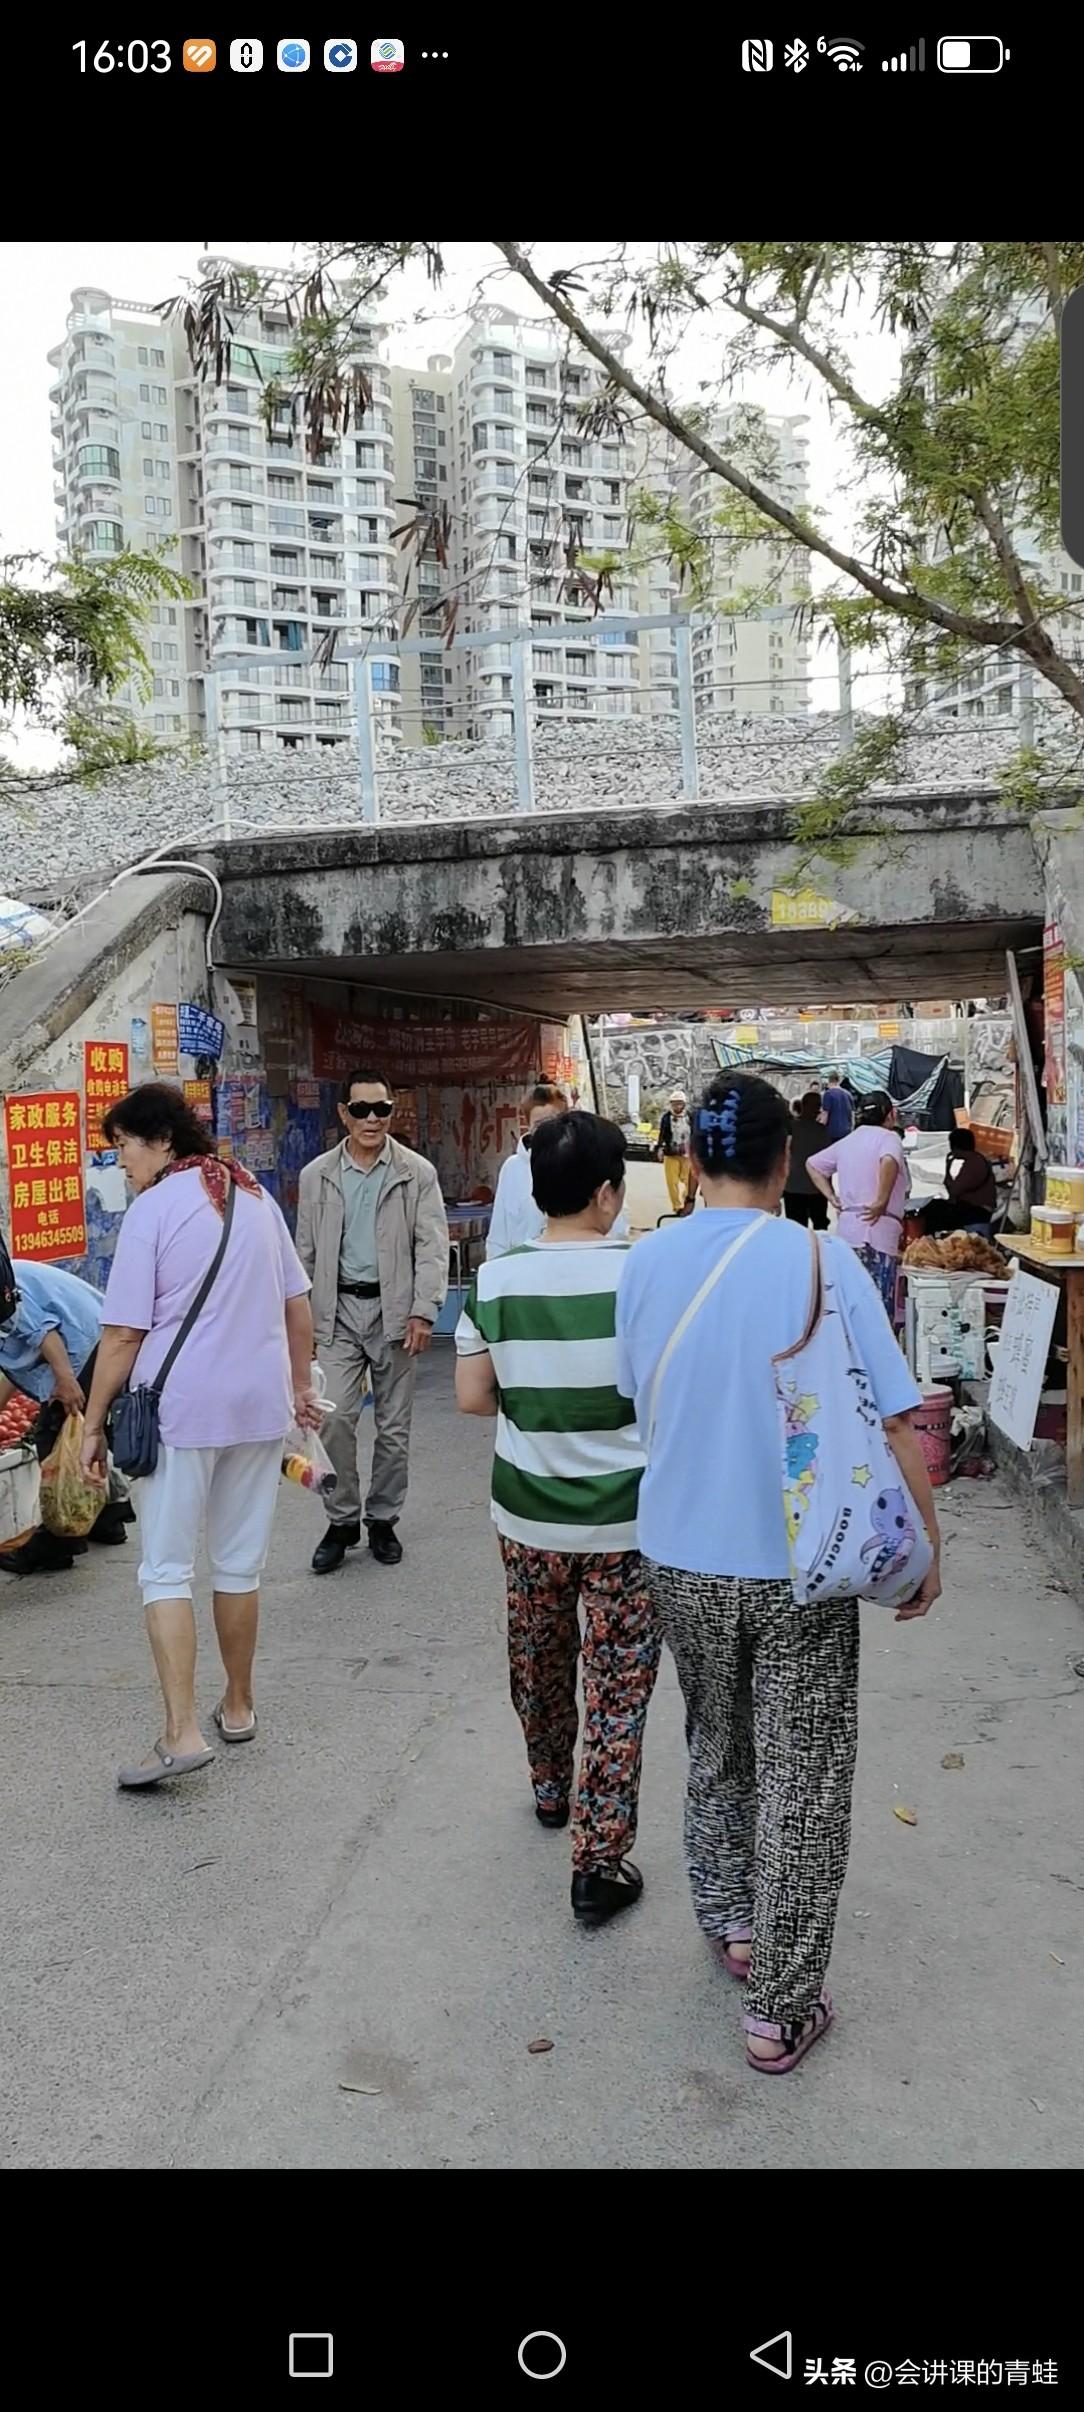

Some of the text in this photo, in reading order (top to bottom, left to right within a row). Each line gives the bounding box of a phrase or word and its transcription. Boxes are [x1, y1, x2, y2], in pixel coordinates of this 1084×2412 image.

[71, 39, 172, 74] 16:03
[90, 1046, 124, 1073] 收购
[9, 1101, 77, 1130] 家政服务
[12, 1138, 78, 1169] 卫生保洁
[14, 1176, 80, 1208] 房屋出租
[37, 1209, 60, 1226] 电话
[15, 1225, 84, 1251] 13946345509
